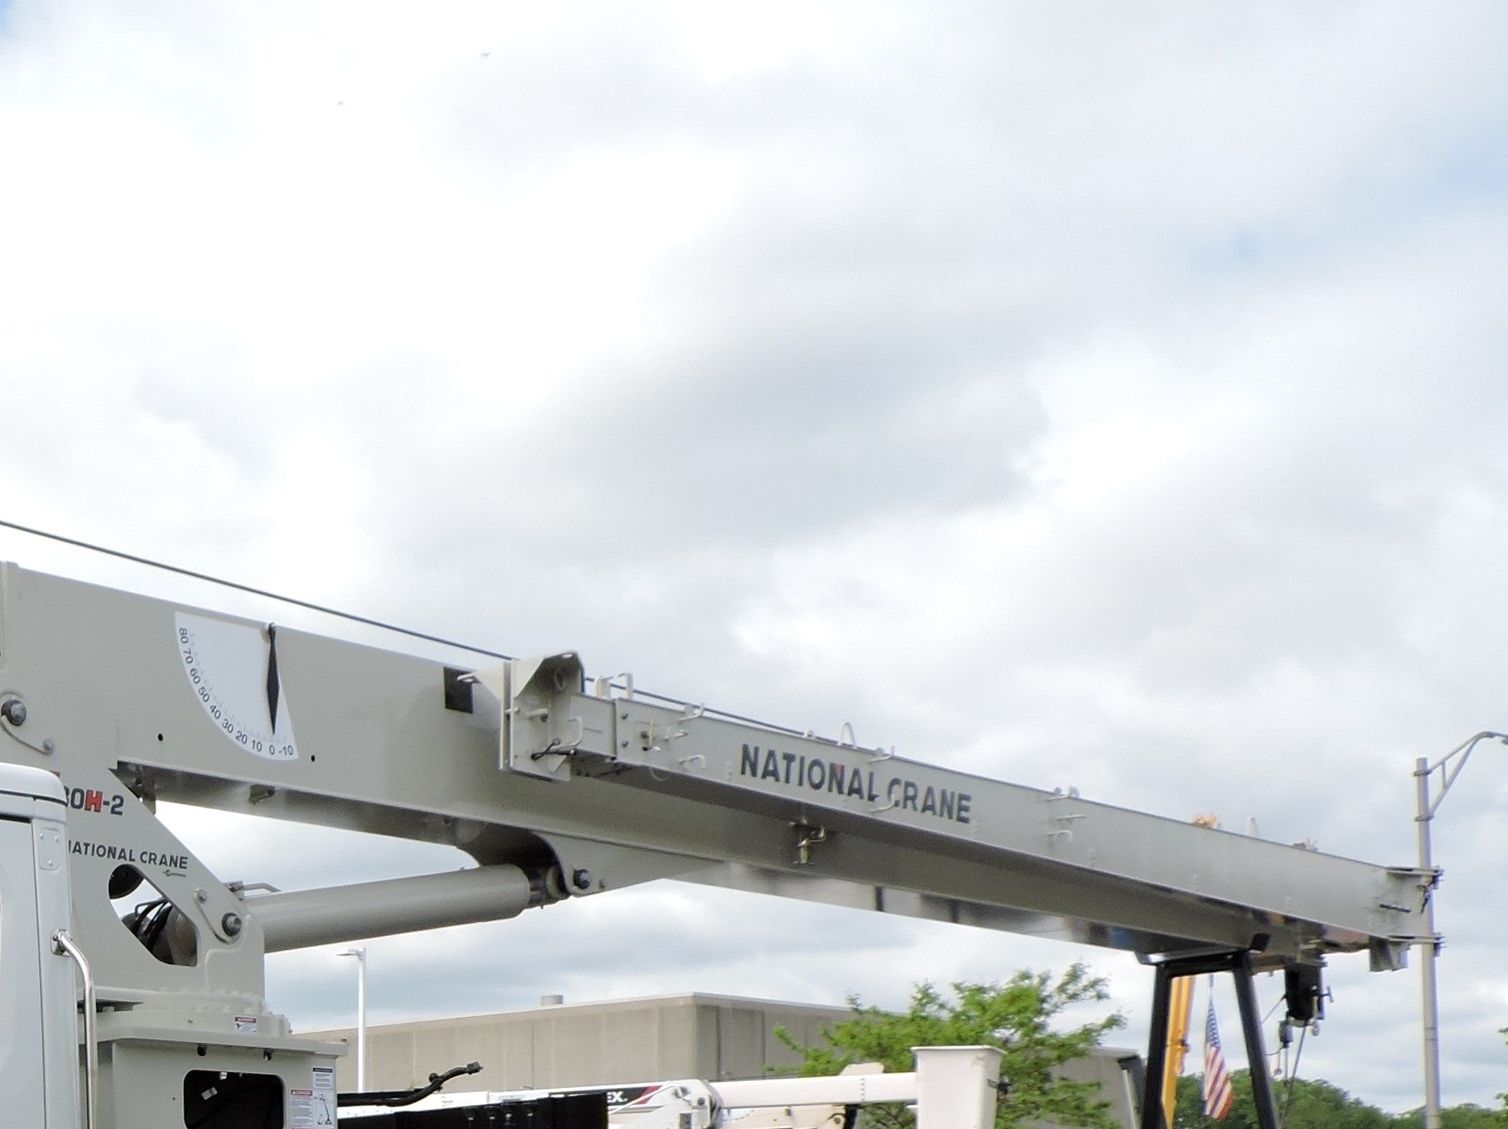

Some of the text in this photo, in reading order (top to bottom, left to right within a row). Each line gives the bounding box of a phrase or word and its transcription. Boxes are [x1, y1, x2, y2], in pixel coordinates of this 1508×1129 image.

[179, 627, 294, 756] 80 70 60 50 40 30 20 10 0 -10
[740, 743, 972, 824] NATIONAL CRANE
[139, 850, 189, 870] CRANE
